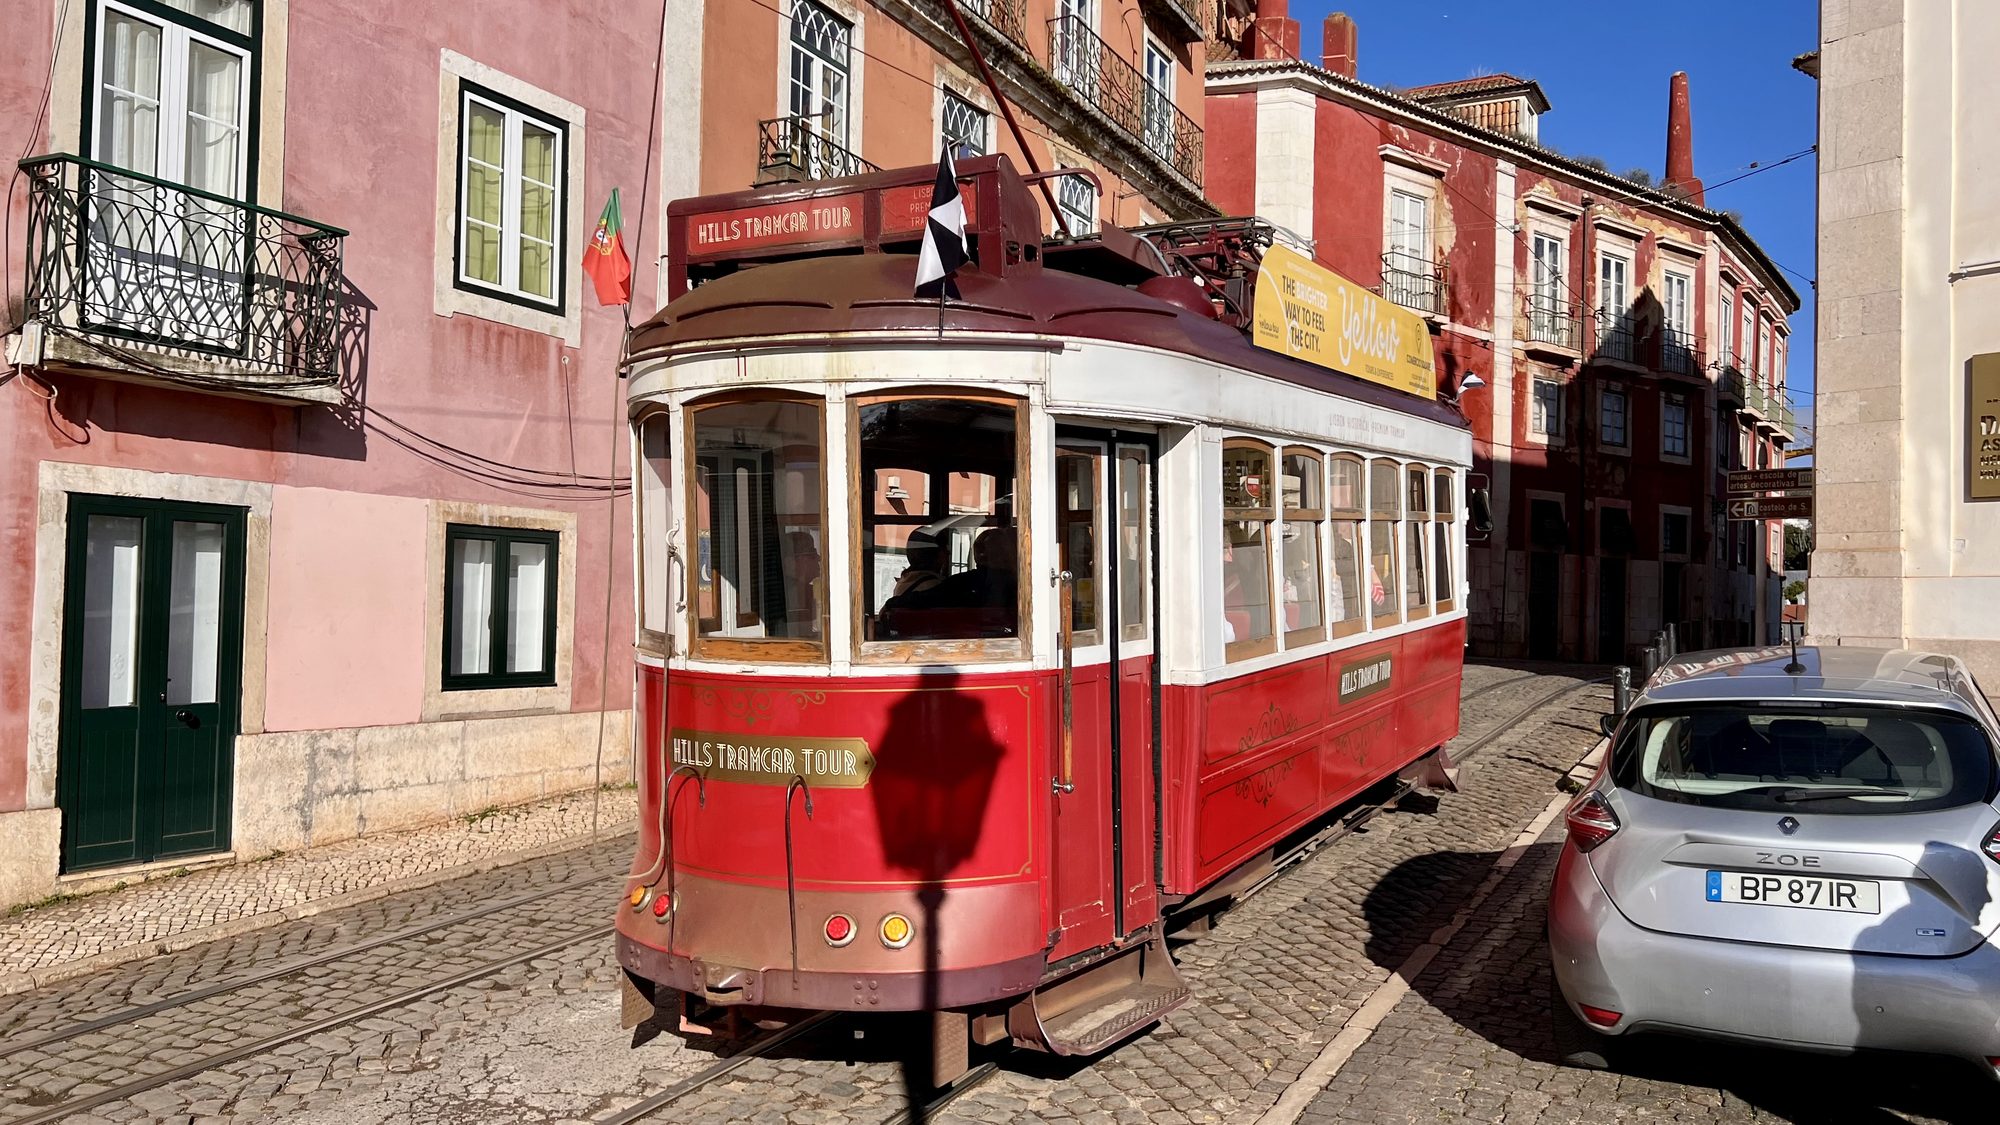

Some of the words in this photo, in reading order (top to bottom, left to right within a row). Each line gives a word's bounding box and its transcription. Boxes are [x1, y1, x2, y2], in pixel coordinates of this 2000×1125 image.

[910, 202, 931, 213] PREM
[699, 219, 741, 244] HILLS
[744, 214, 809, 239] TRAMCAR
[812, 206, 852, 230] TOUR
[1282, 274, 1296, 297] THE
[1296, 281, 1329, 311] BRIGHTER
[1284, 300, 1301, 322] WAY
[1302, 307, 1312, 327] TO
[1312, 311, 1326, 332] FEEL
[1290, 326, 1303, 347] THE
[1304, 331, 1321, 353] CITY.
[1730, 482, 1748, 490] artes
[1750, 480, 1795, 489] decorativas
[1760, 471, 1785, 480] escola
[1787, 470, 1797, 478] de
[1759, 503, 1786, 512] castelo
[1788, 503, 1797, 511] de
[1341, 670, 1358, 696] HILLS
[673, 738, 713, 768] HILLS
[716, 743, 796, 774] TRAMCAR
[801, 748, 857, 776] TOUR
[1756, 852, 1821, 868] ZOE
[1711, 889, 1718, 897] P
[1740, 876, 1782, 902] BP
[1788, 879, 1823, 905] 87
[1829, 881, 1857, 908] IR
